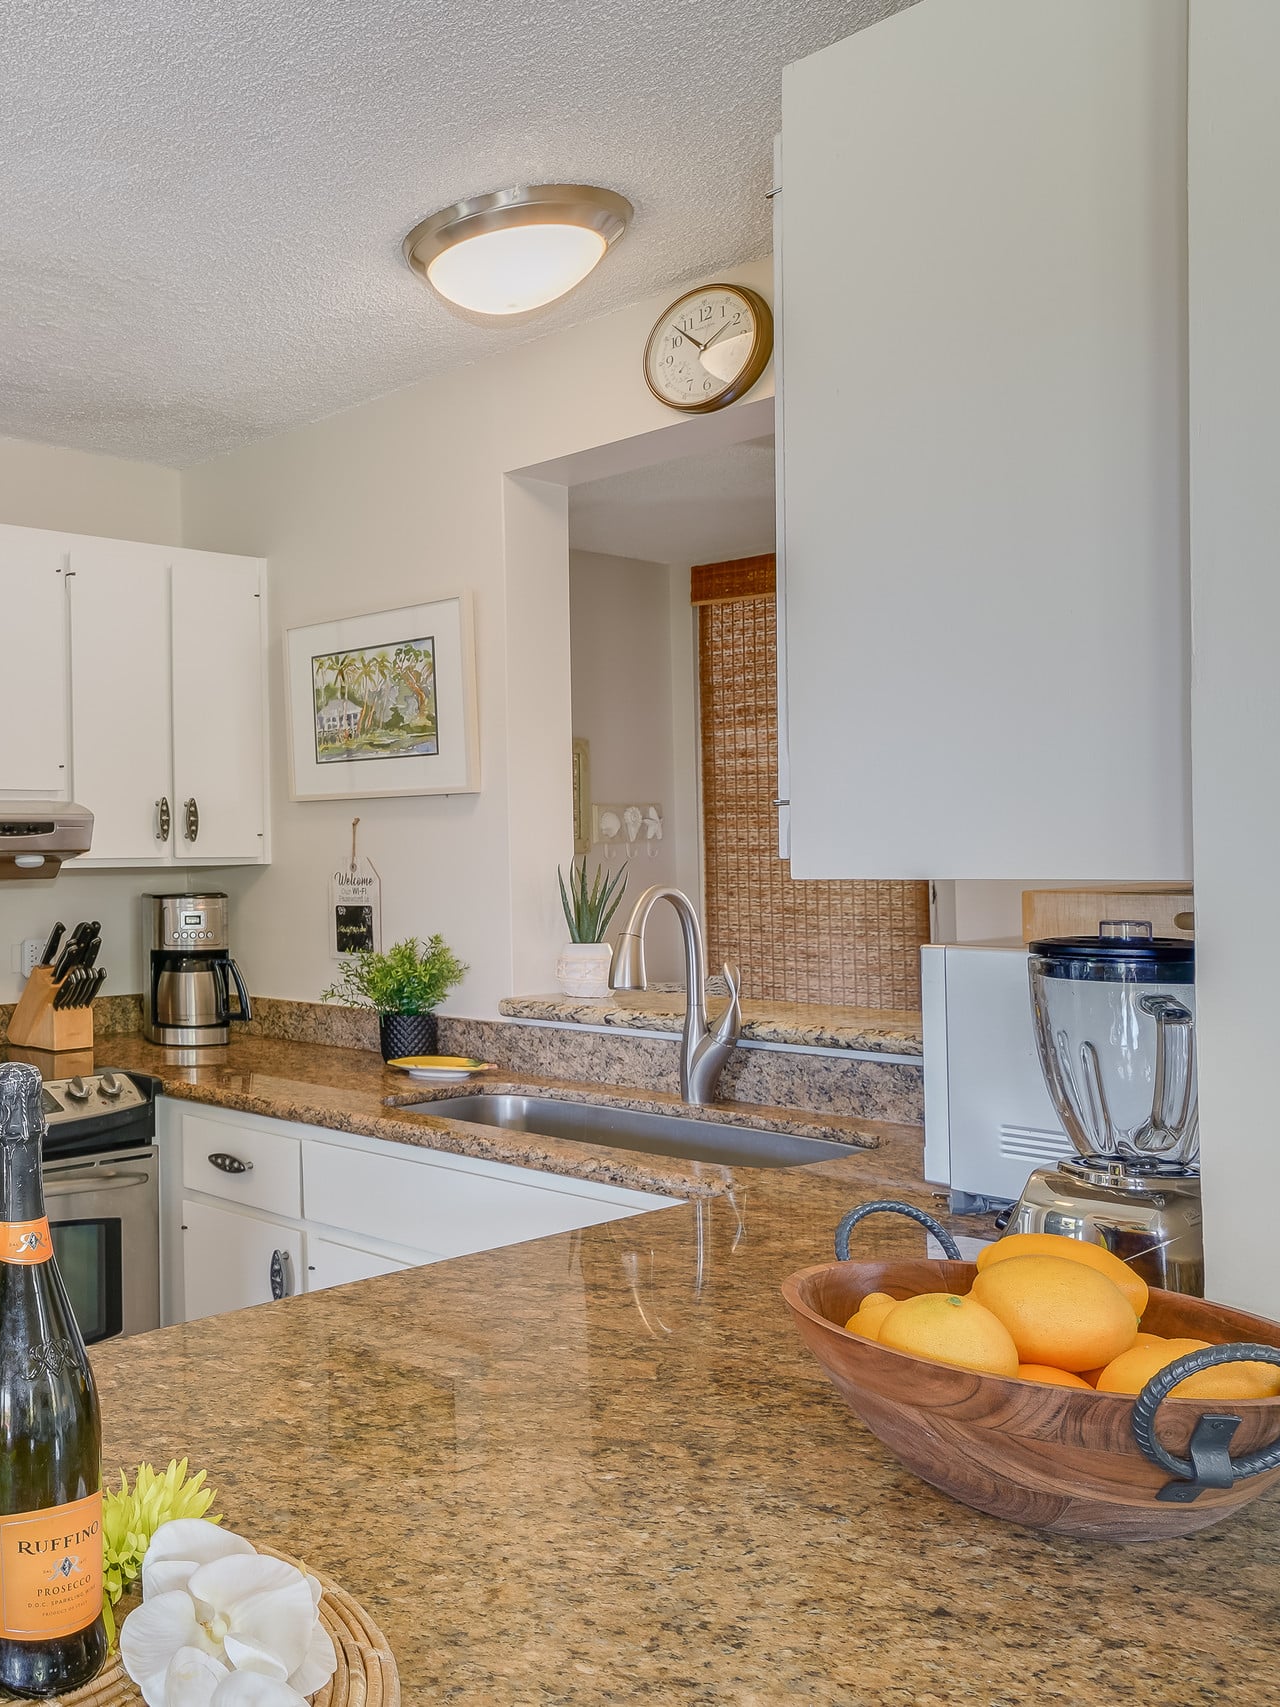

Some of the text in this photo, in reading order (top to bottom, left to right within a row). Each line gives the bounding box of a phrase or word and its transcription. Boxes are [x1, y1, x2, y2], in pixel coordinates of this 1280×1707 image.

[699, 305, 712, 322] 12
[732, 312, 741, 325] 2
[683, 318, 693, 332] 11
[672, 335, 683, 349] 10
[665, 355, 674, 368] 9
[686, 379, 694, 391] 7
[703, 377, 712, 390] 6
[334, 871, 374, 886] Welcome
[17, 1520, 99, 1555] RUFFINO
[37, 1574, 91, 1597] PROSECCO
[51, 1592, 83, 1606] SPARKLING
